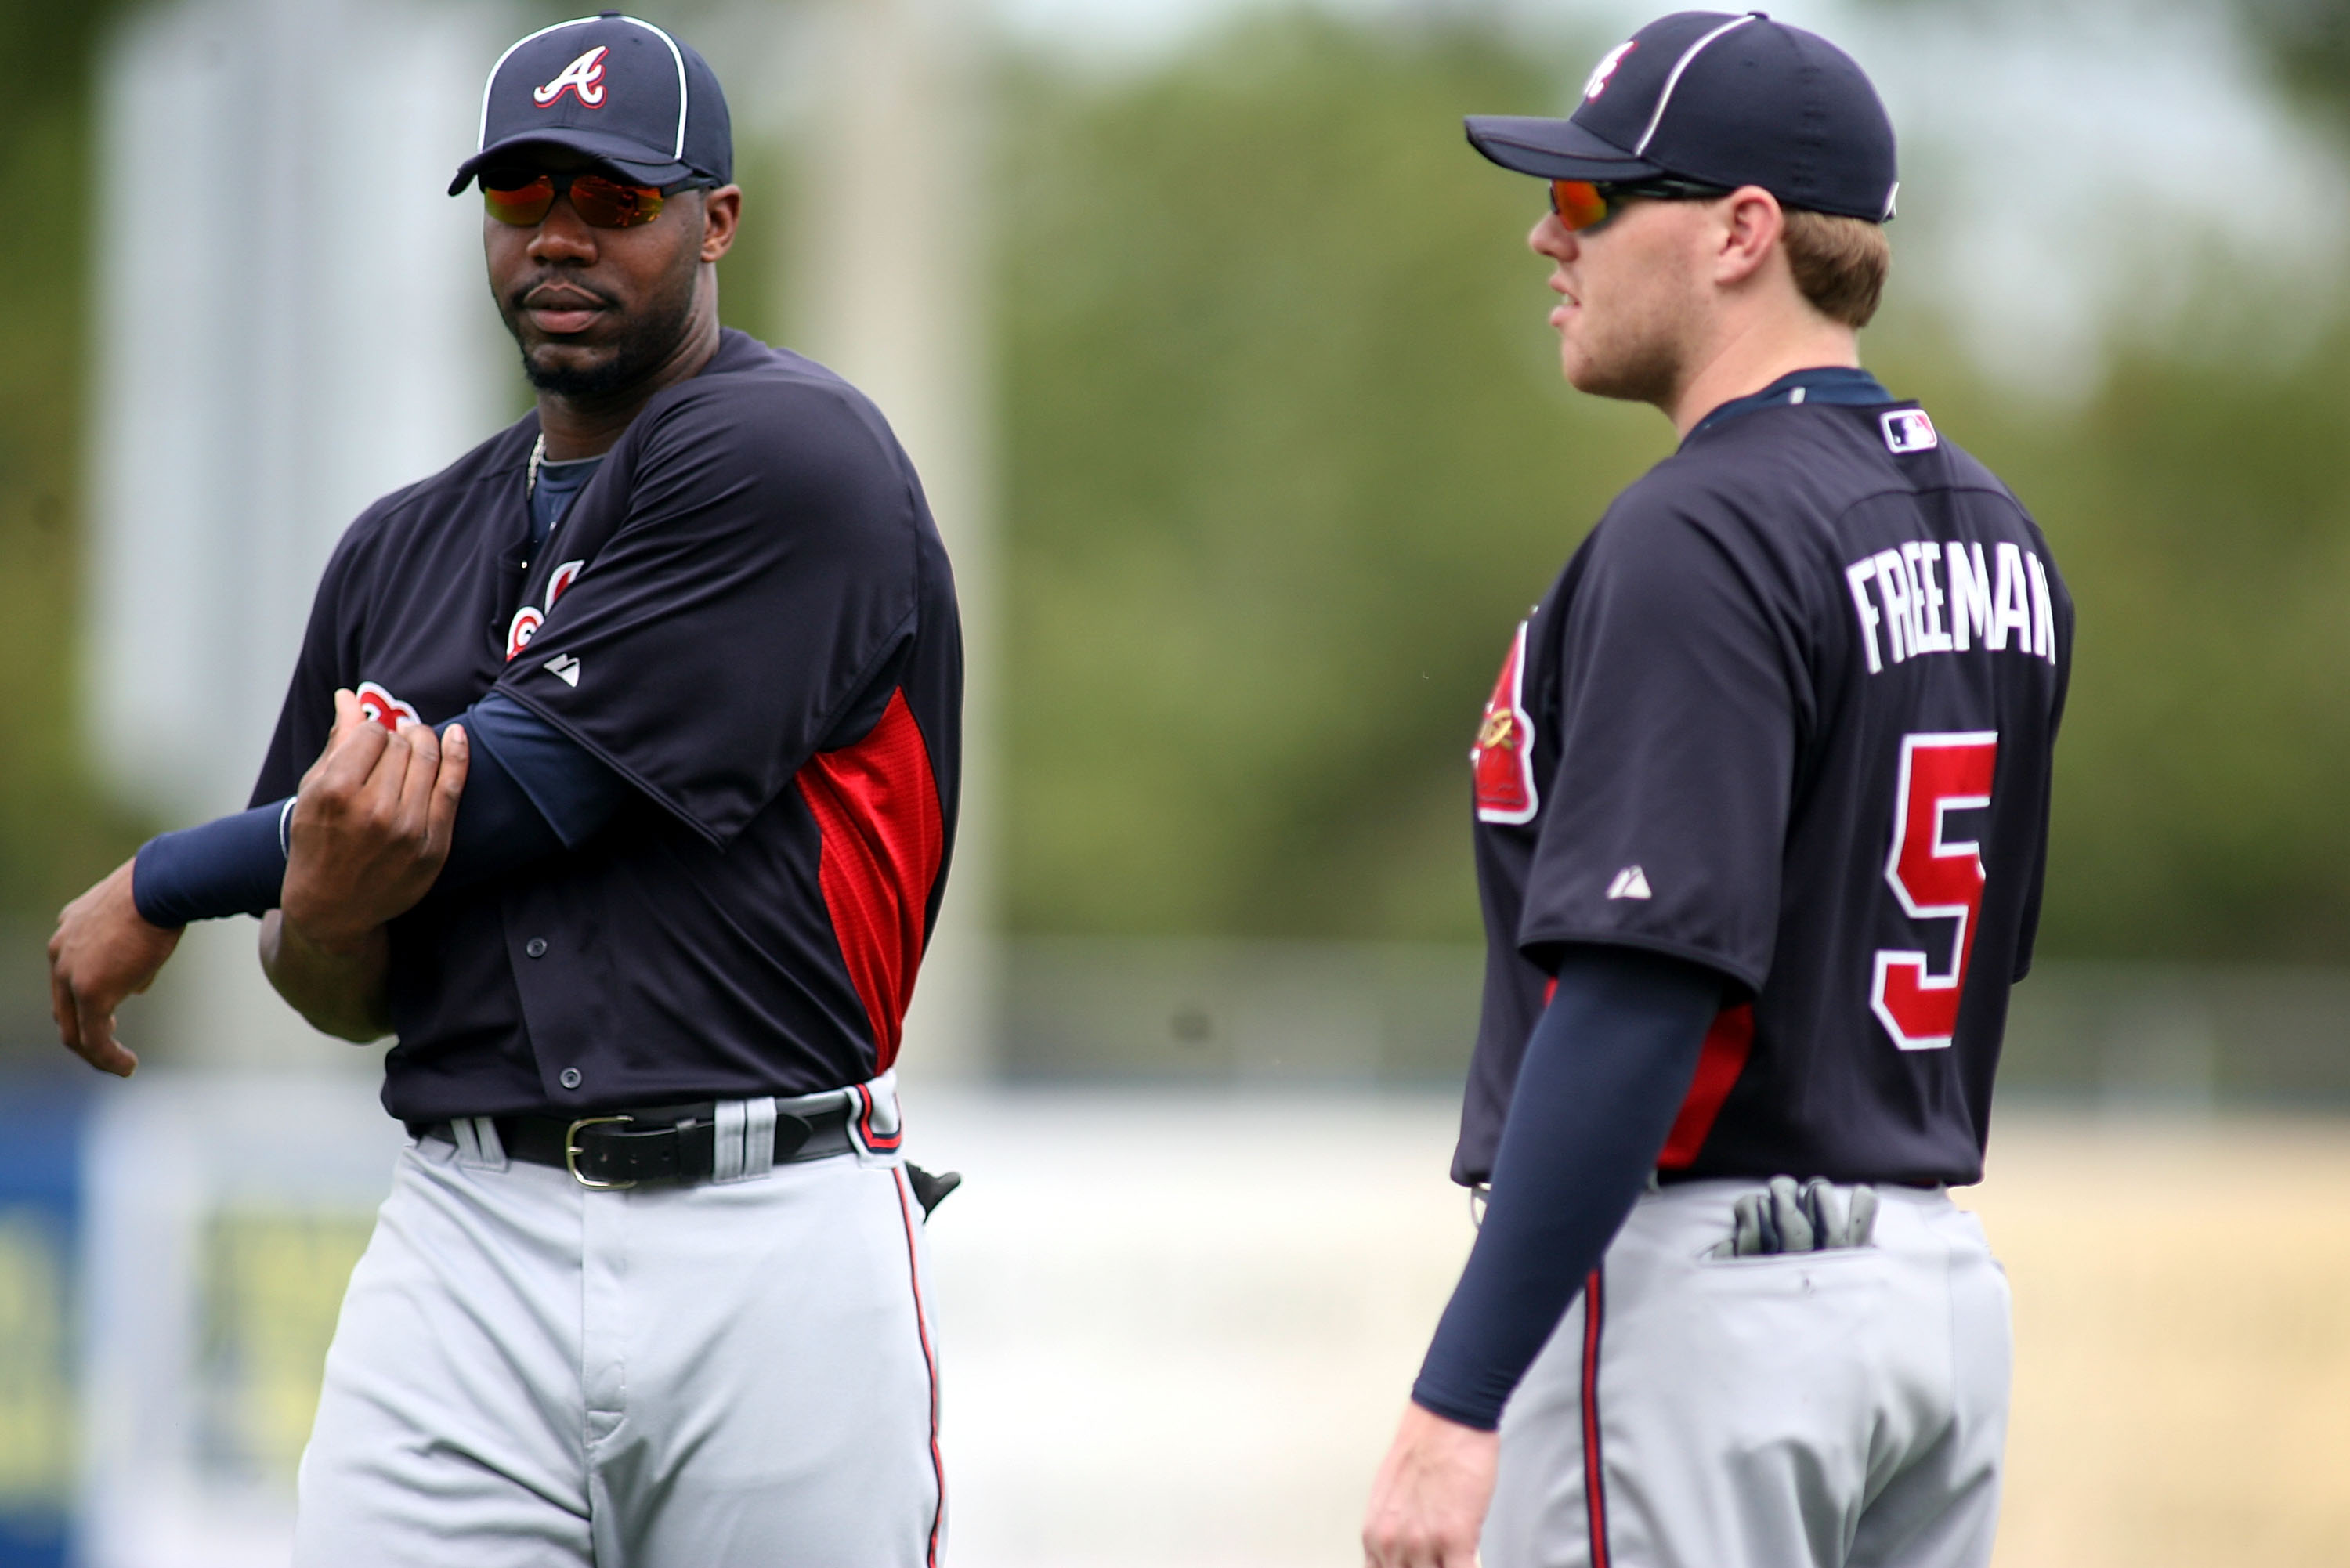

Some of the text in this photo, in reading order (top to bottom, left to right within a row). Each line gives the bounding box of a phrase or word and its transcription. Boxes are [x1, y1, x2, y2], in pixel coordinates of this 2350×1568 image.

[533, 45, 609, 109] A
[1846, 541, 2055, 674] FREEMAN
[1870, 732, 1998, 1050] 5
